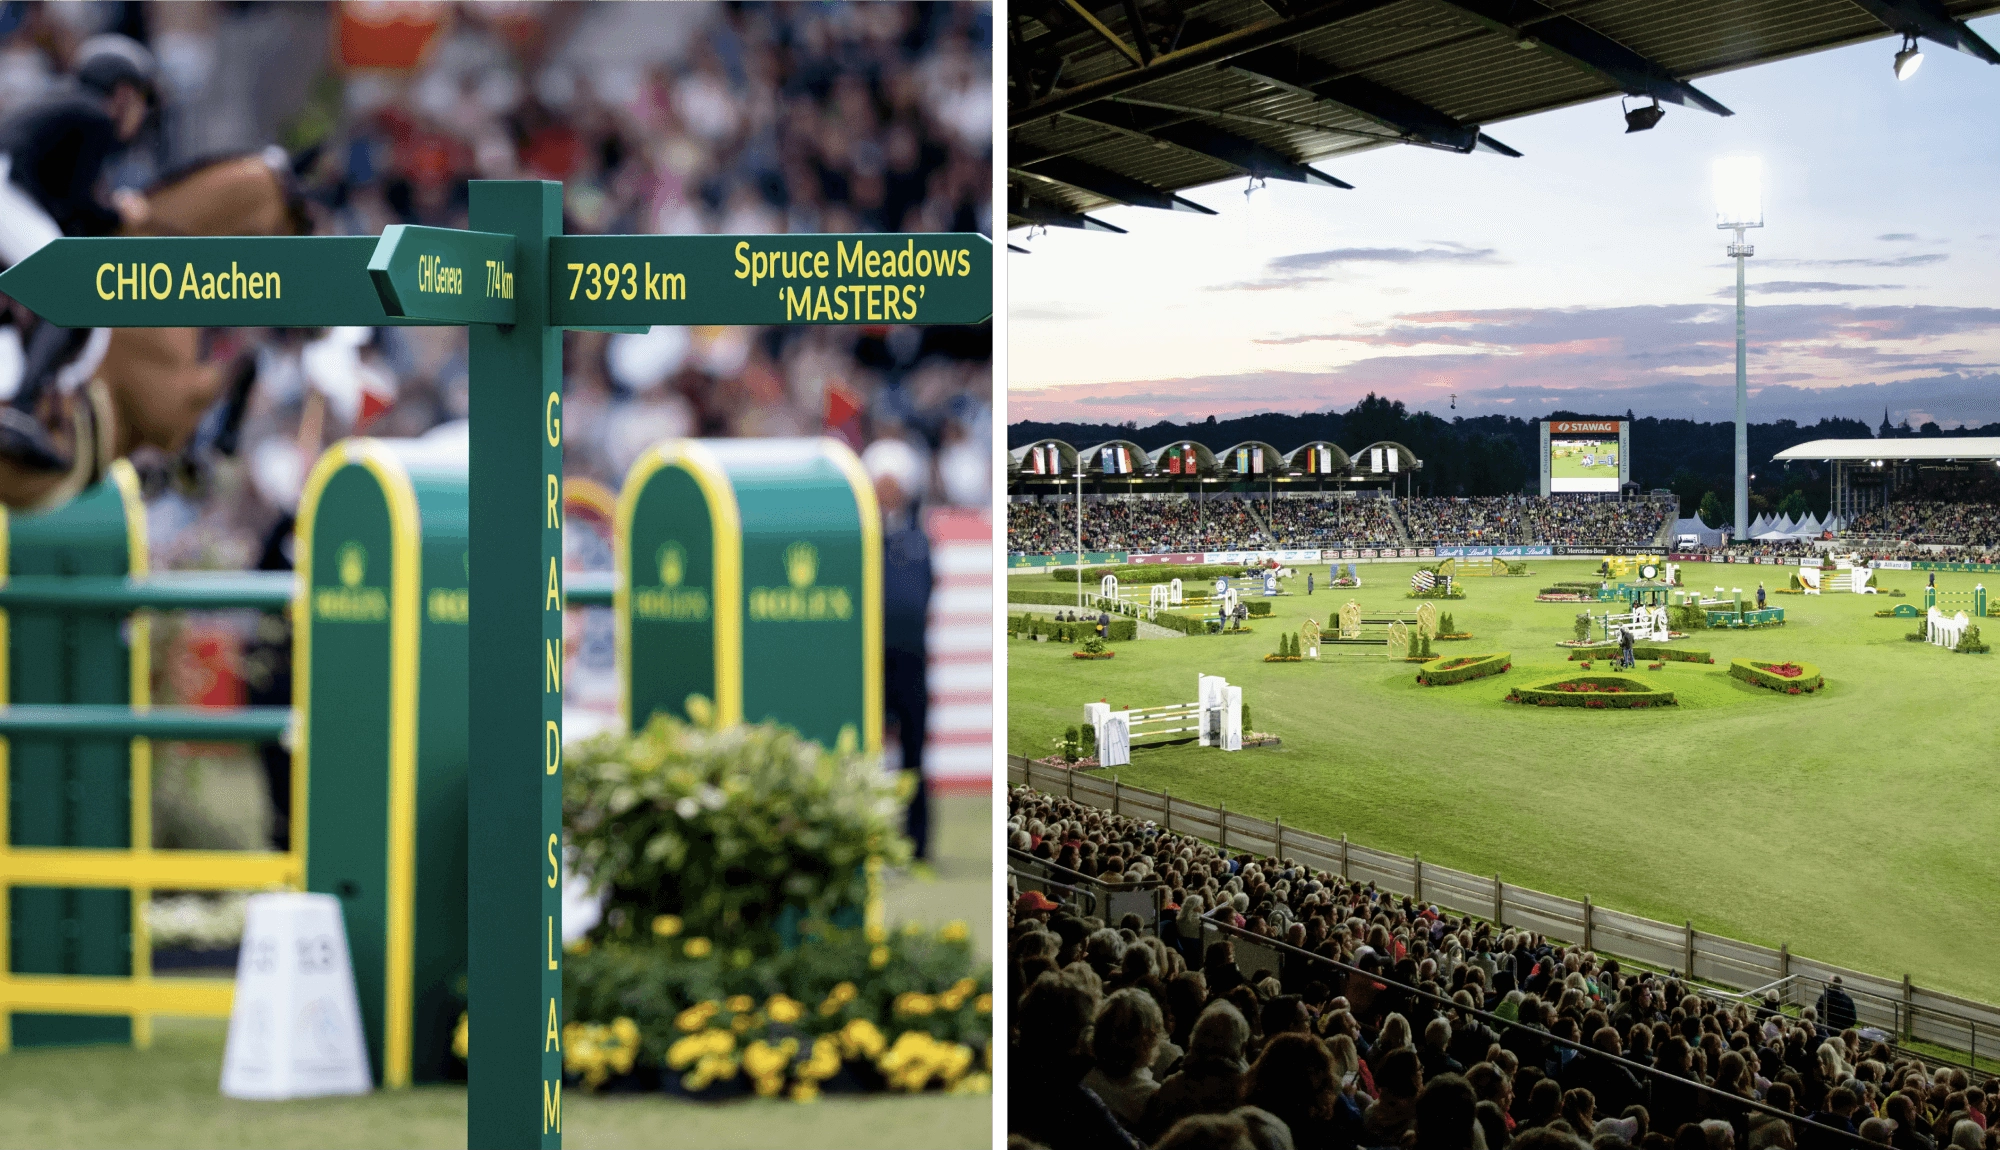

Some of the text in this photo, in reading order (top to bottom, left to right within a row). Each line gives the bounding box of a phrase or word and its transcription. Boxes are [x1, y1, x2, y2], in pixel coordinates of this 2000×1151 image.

[95, 260, 281, 301] CHIO Aachen
[418, 254, 462, 295] CHI Geneva
[486, 260, 514, 299] 774 km
[567, 261, 687, 301] 7393 km
[734, 238, 971, 287] Spruce Meadows
[1571, 423, 1612, 431] STAWAG
[1438, 548, 1458, 556] Lindt
[1467, 548, 1488, 556] Lindt
[1496, 547, 1517, 555] Lindt
[1525, 547, 1545, 555] Lindt
[543, 392, 560, 1134] GRAND SLAM
